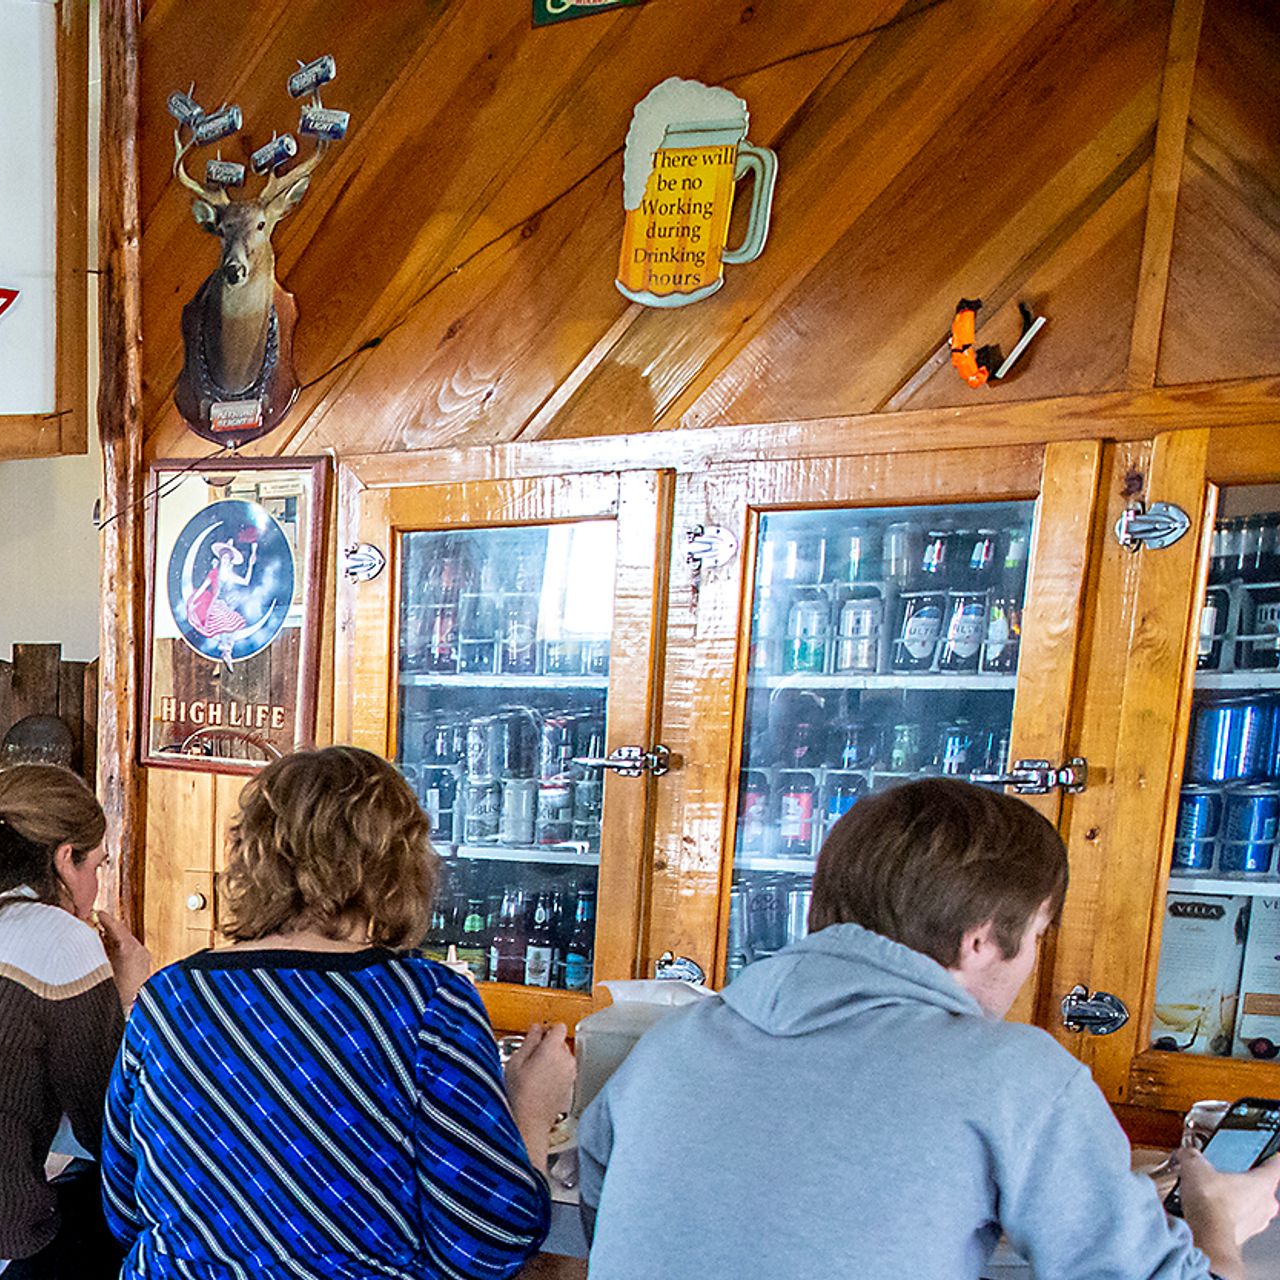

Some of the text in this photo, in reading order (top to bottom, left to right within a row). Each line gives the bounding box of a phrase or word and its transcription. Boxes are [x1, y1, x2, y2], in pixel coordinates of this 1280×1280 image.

[651, 147, 734, 169] There will
[657, 174, 703, 192] be no
[641, 198, 713, 219] Working
[646, 221, 701, 243] during
[633, 247, 706, 268] Drinking
[648, 269, 701, 286] hours
[160, 696, 285, 729] HIGH LIFE
[1176, 904, 1218, 916] VELLA
